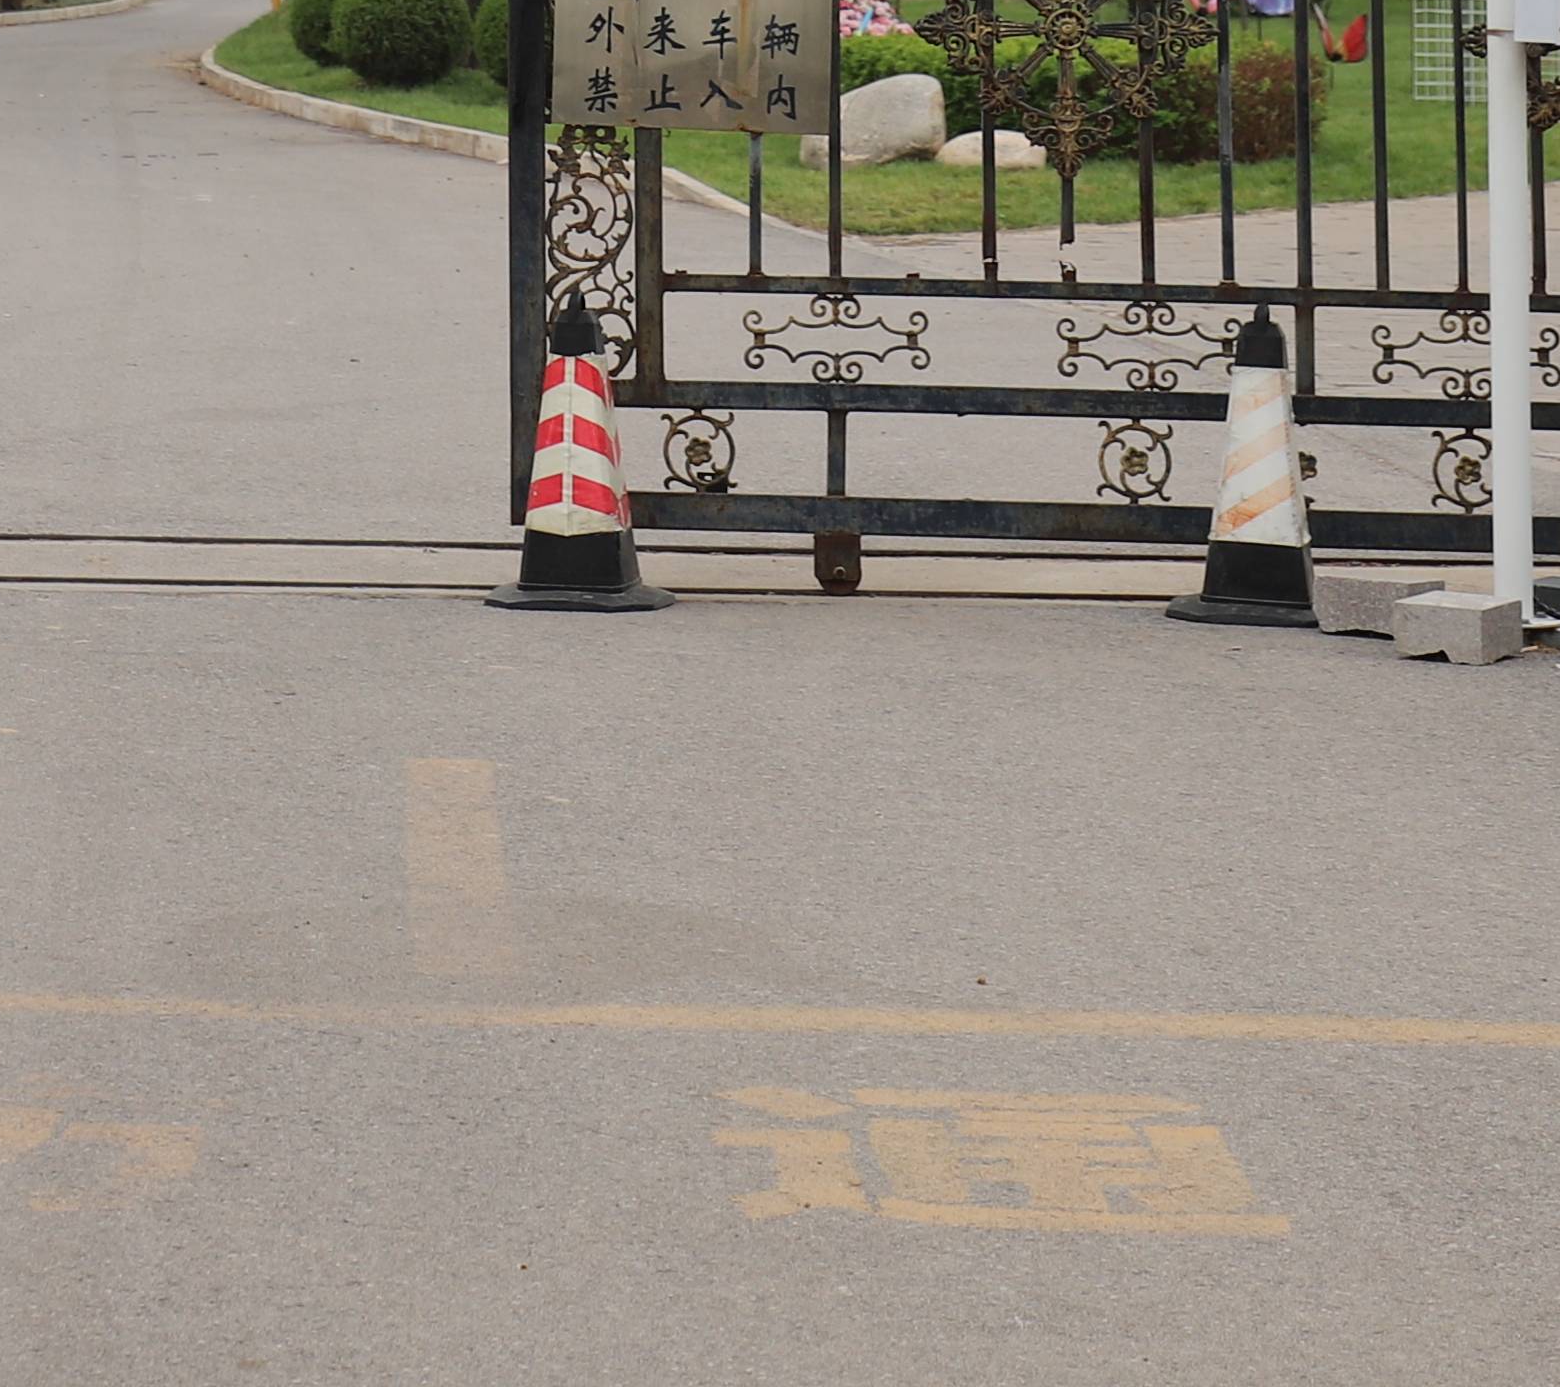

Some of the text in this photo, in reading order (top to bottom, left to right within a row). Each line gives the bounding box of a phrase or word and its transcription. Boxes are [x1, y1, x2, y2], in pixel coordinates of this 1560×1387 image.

[584, 5, 801, 60] 外来车辆
[583, 66, 797, 121] 禁止入内
